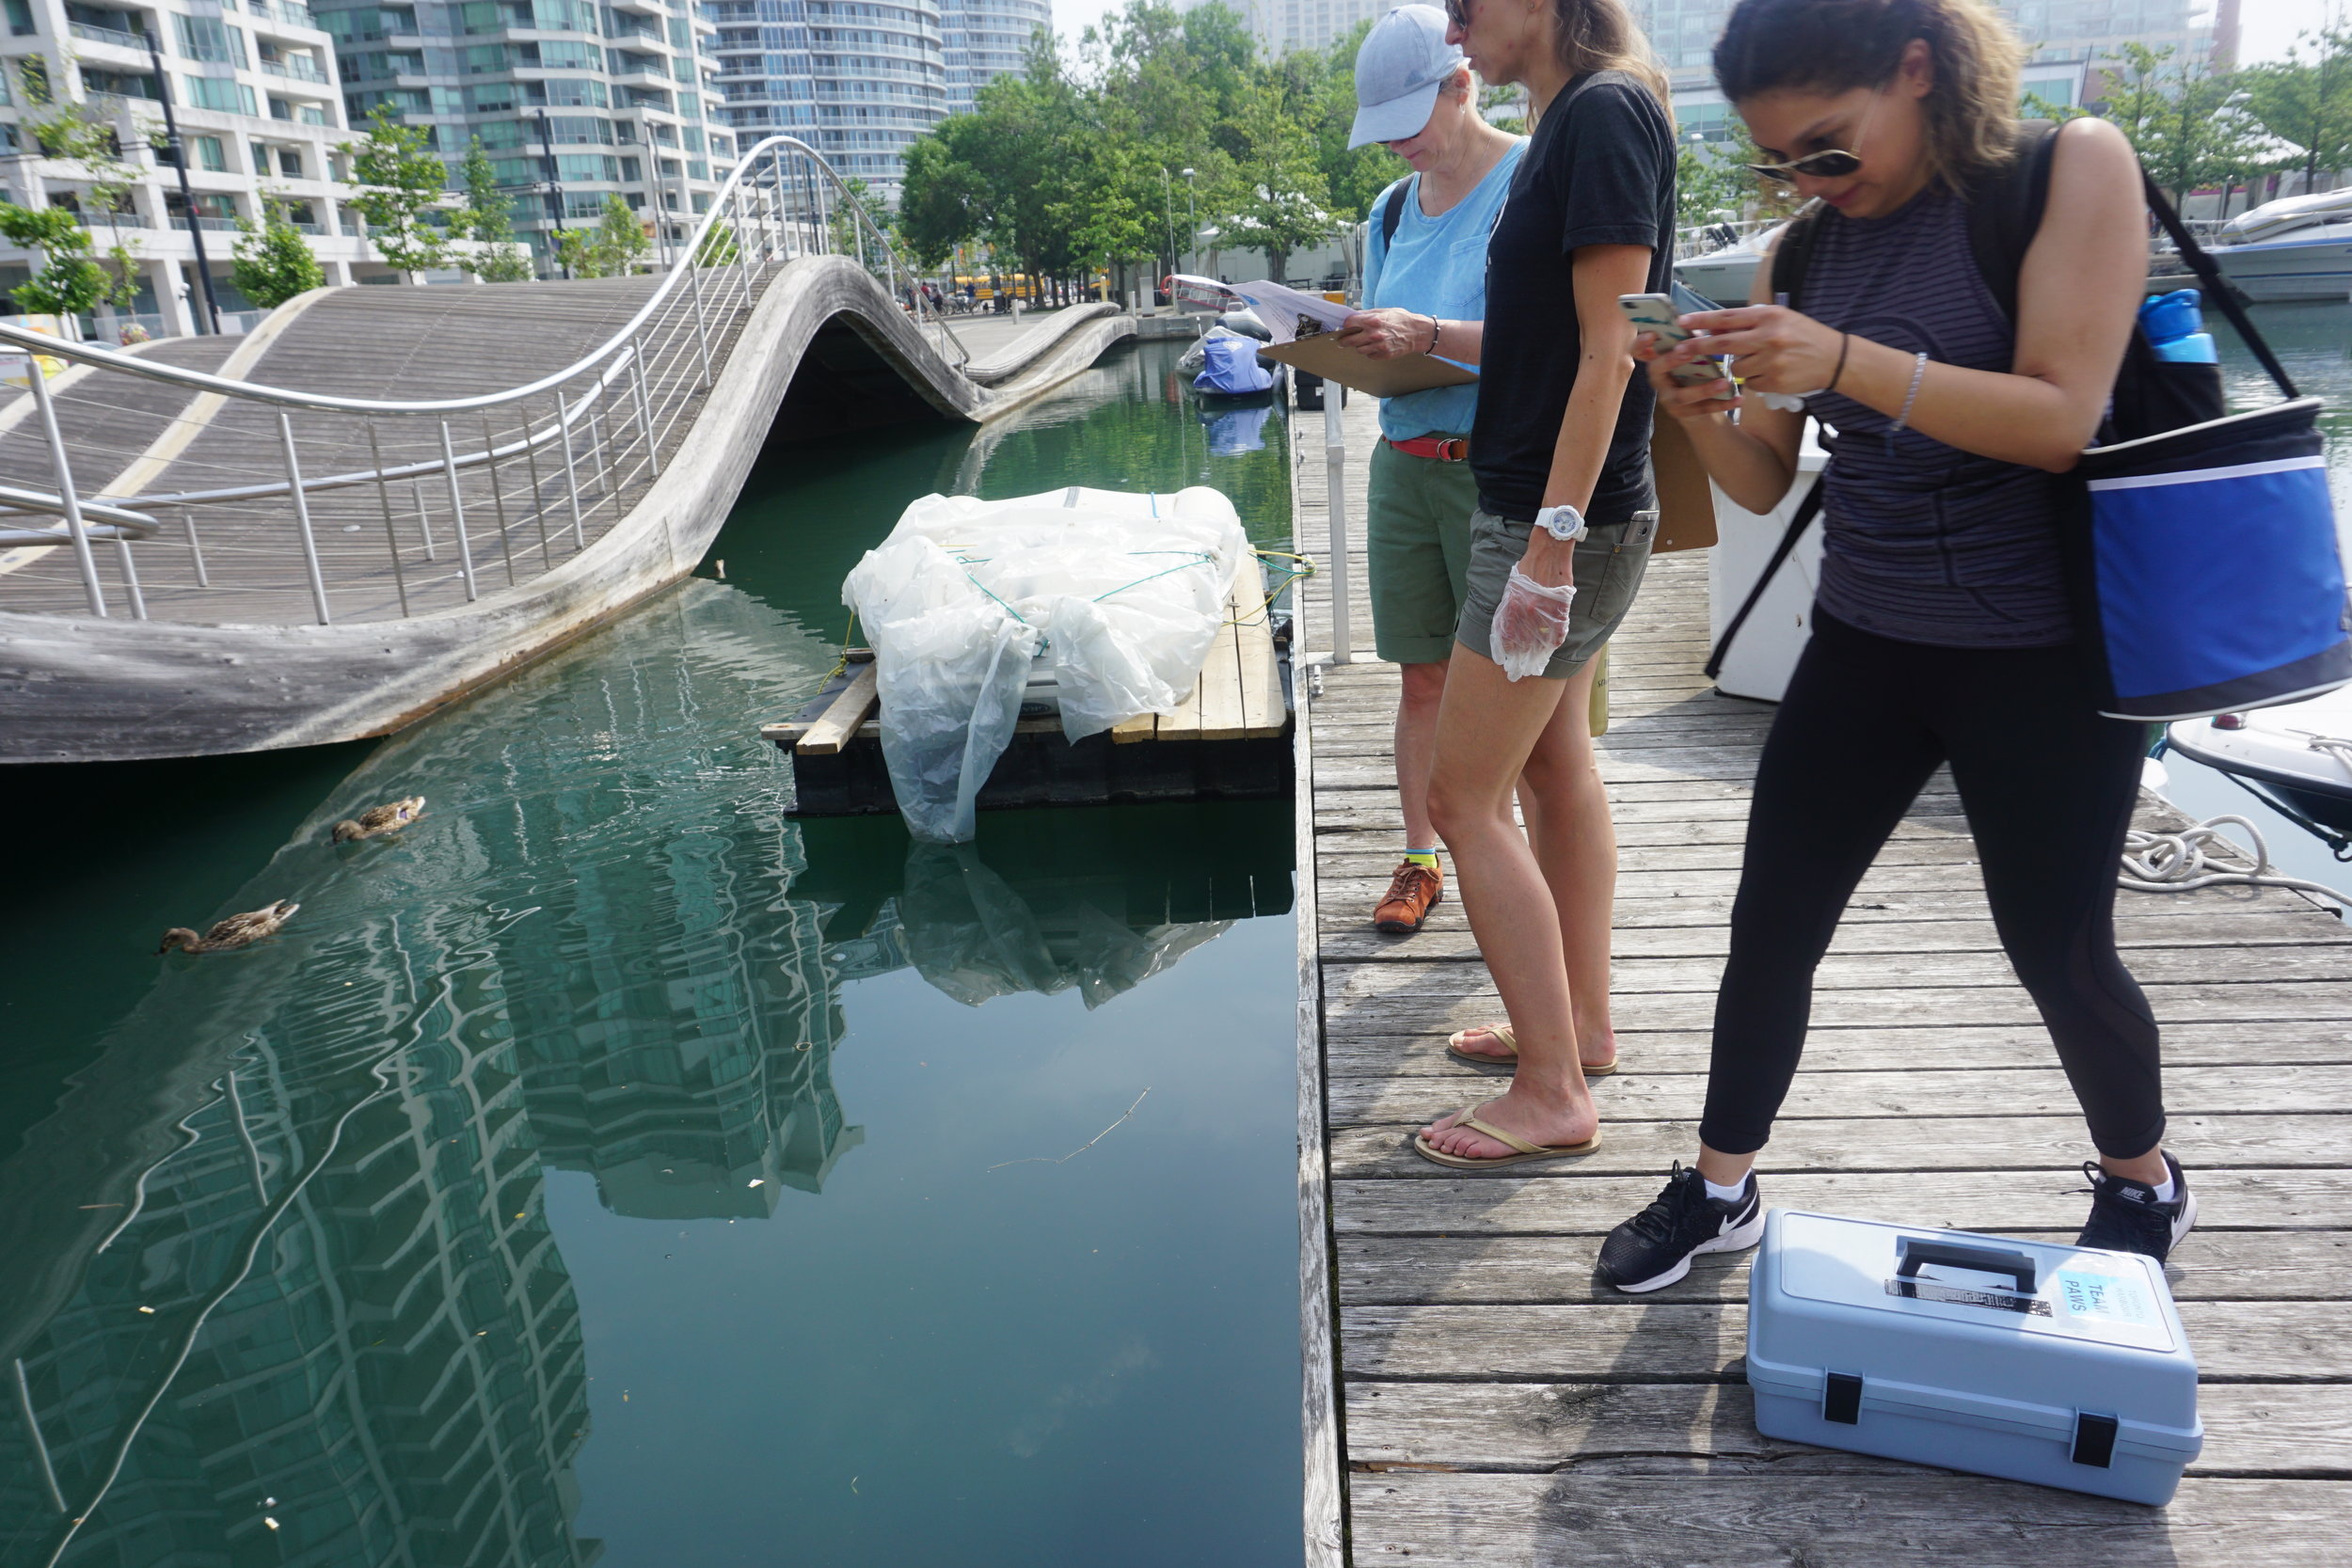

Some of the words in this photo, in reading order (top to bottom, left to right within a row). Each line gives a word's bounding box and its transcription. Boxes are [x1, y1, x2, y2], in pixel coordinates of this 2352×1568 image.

[2121, 1186, 2145, 1200] NIKE
[2065, 1279, 2087, 1312] PAWS
[2089, 1284, 2110, 1314] TEAM
